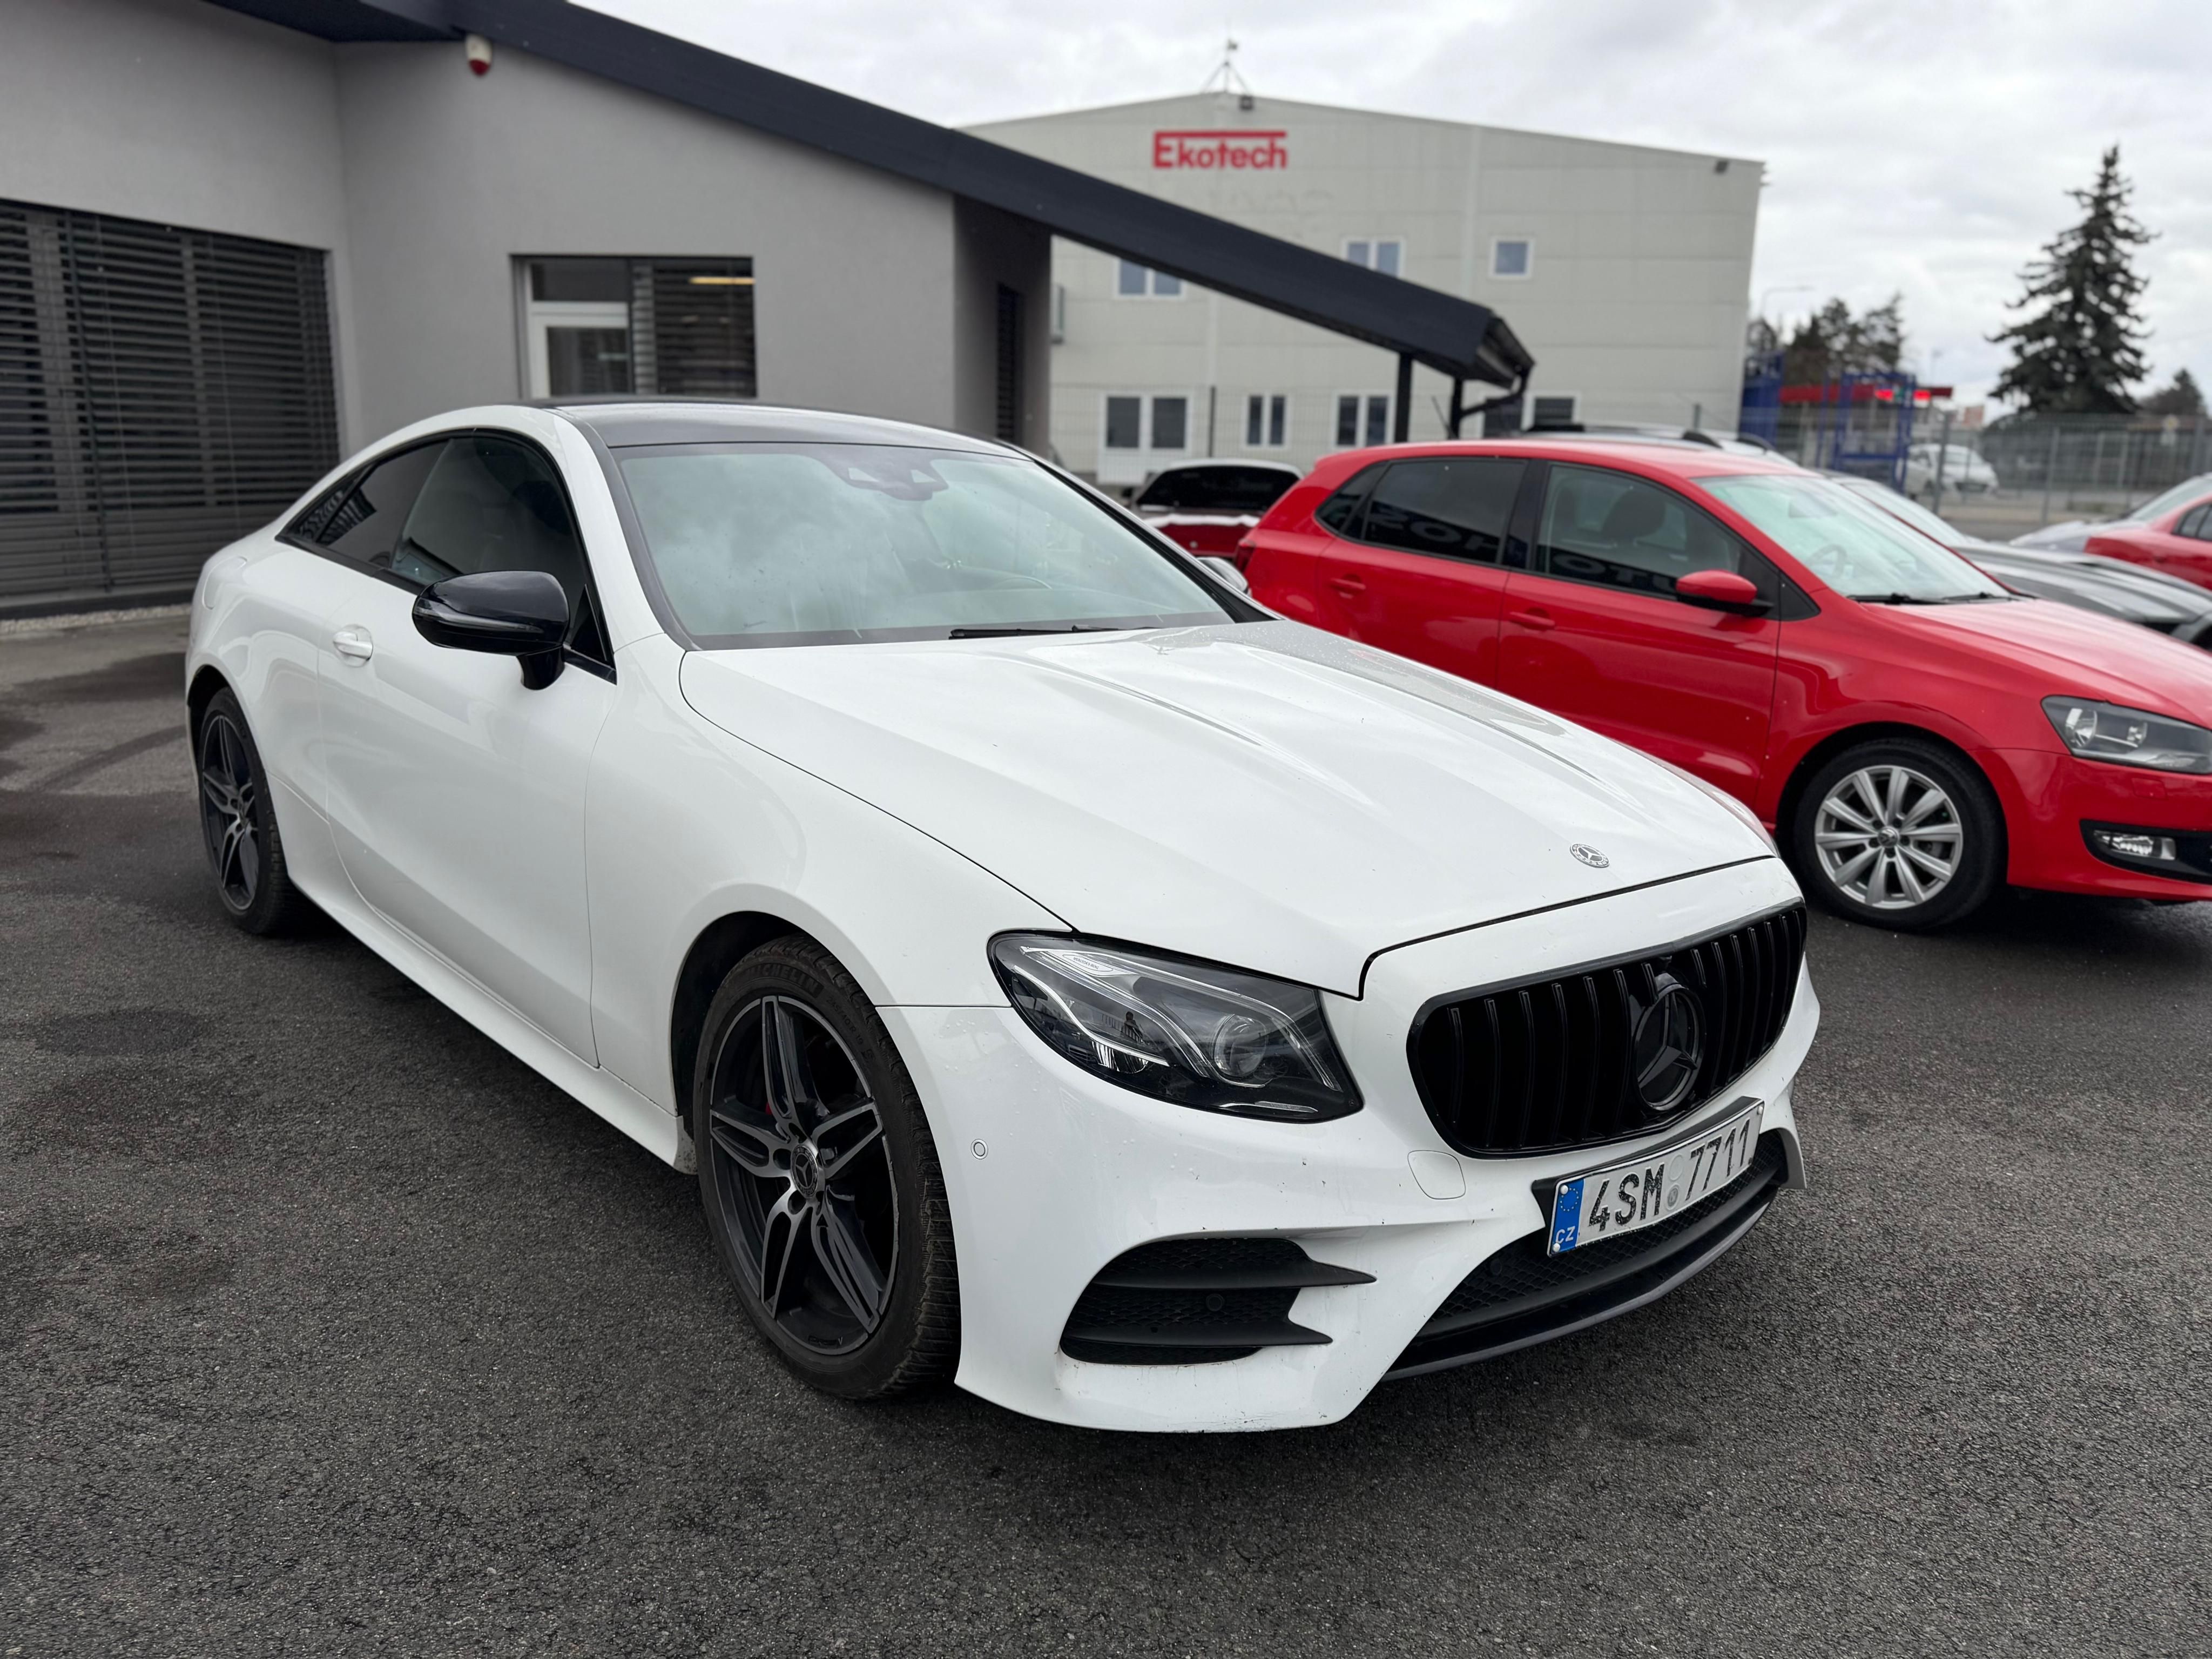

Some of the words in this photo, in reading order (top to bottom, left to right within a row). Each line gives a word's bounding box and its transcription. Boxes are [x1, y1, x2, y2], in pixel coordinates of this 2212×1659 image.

[1152, 130, 1287, 169] Ekotech
[744, 963, 819, 994] MICHELIN
[1588, 1162, 1665, 1232] 4SM
[1685, 1117, 1750, 1201] 7711
[1555, 1226, 1576, 1244] CZ
